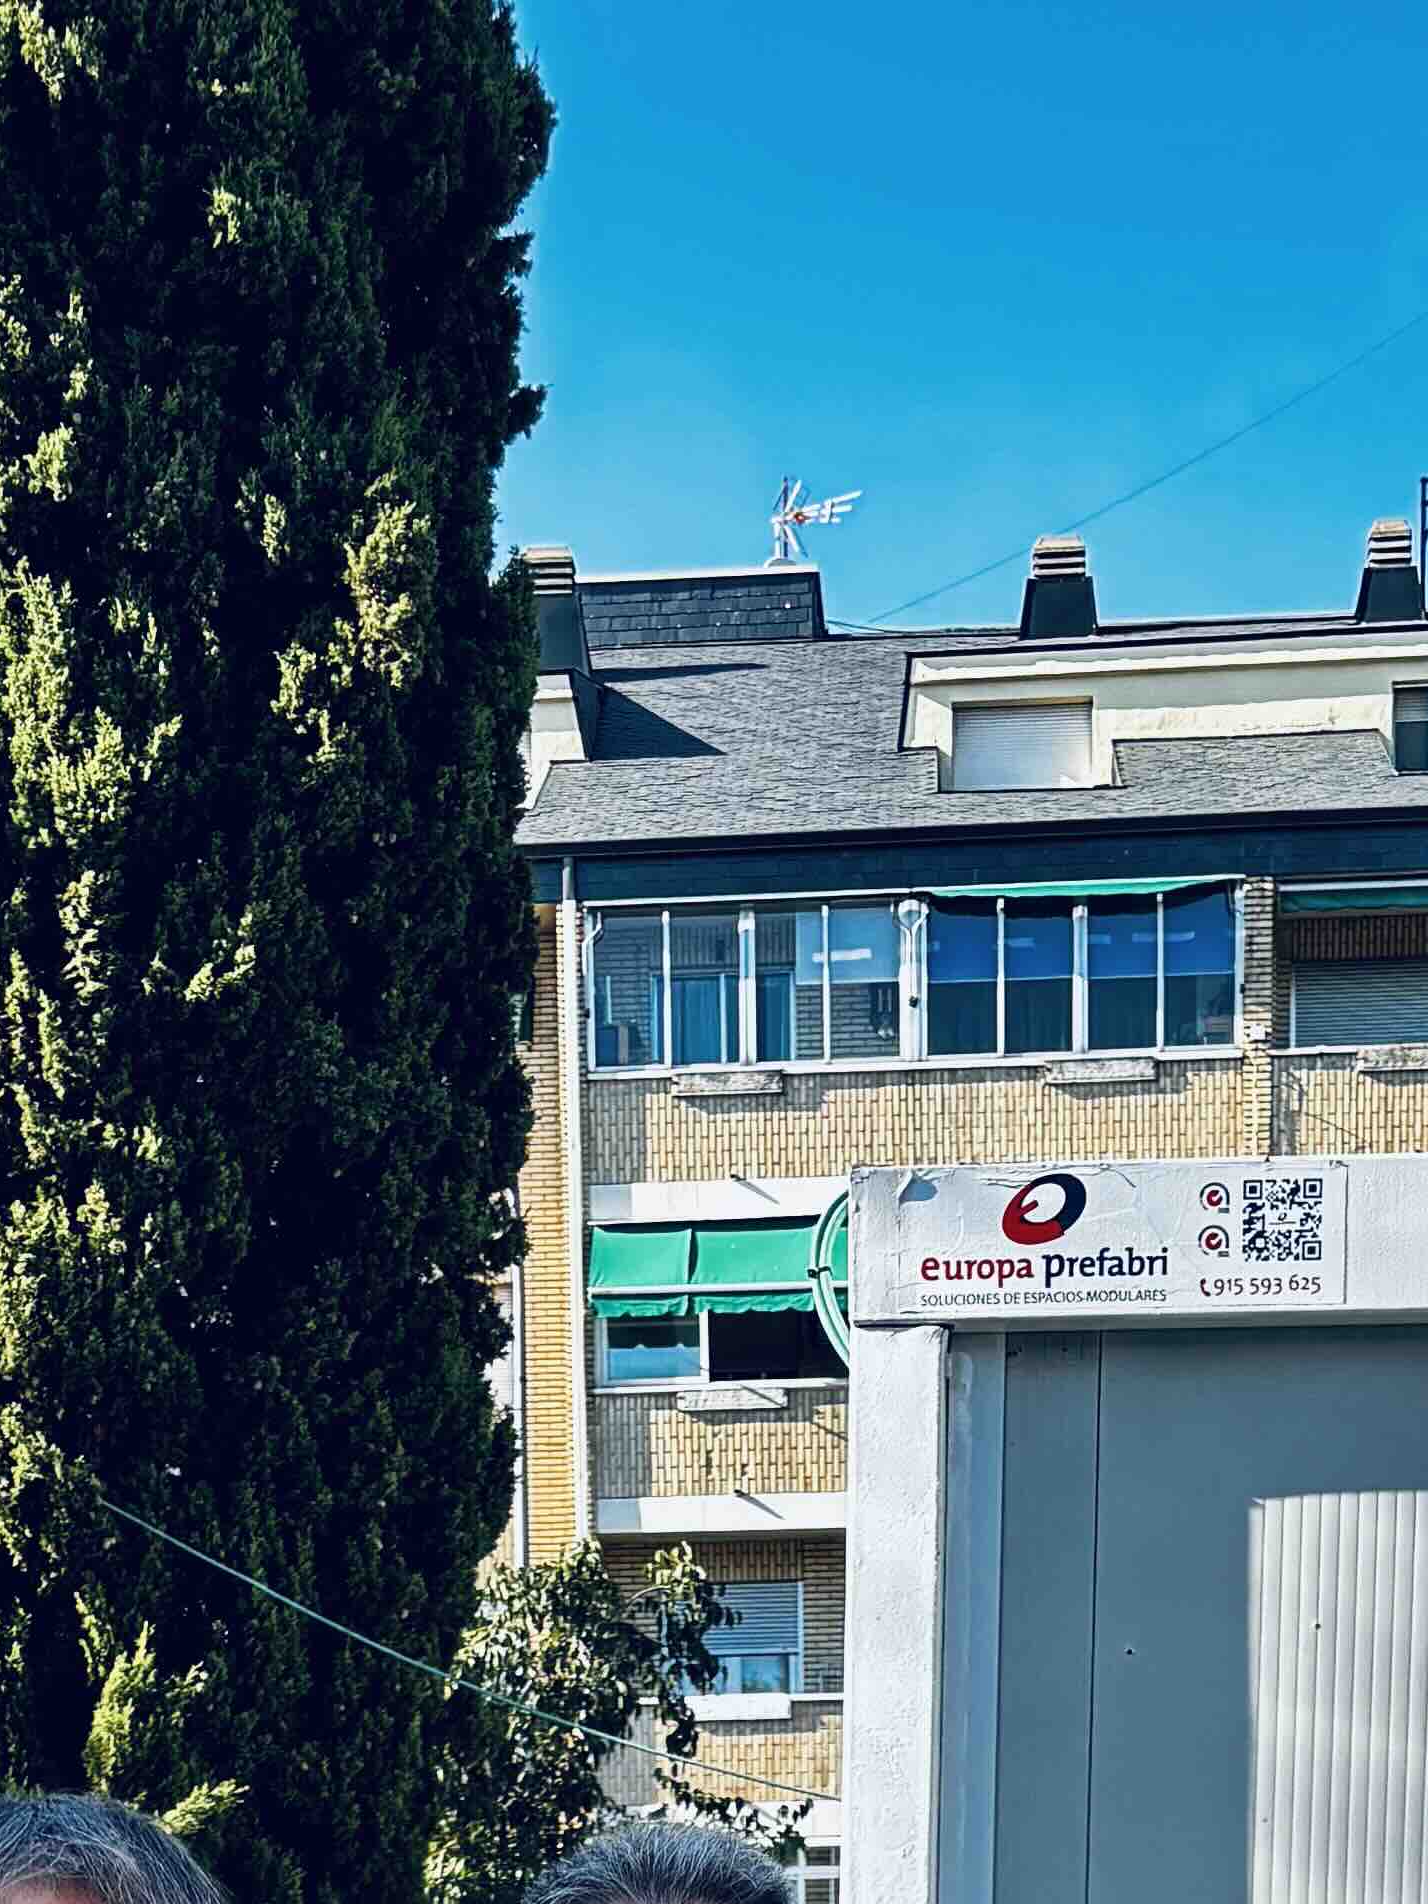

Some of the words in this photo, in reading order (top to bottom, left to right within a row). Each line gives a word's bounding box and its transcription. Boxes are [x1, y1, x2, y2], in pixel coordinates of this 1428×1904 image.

[921, 1257, 1034, 1288] europa
[1041, 1247, 1168, 1288] prefabri
[1213, 1278, 1243, 1297] 915
[1250, 1278, 1282, 1296] 593
[1289, 1274, 1321, 1294] 625
[920, 1293, 1001, 1306] SOLUCIONES
[1004, 1292, 1021, 1304] DE
